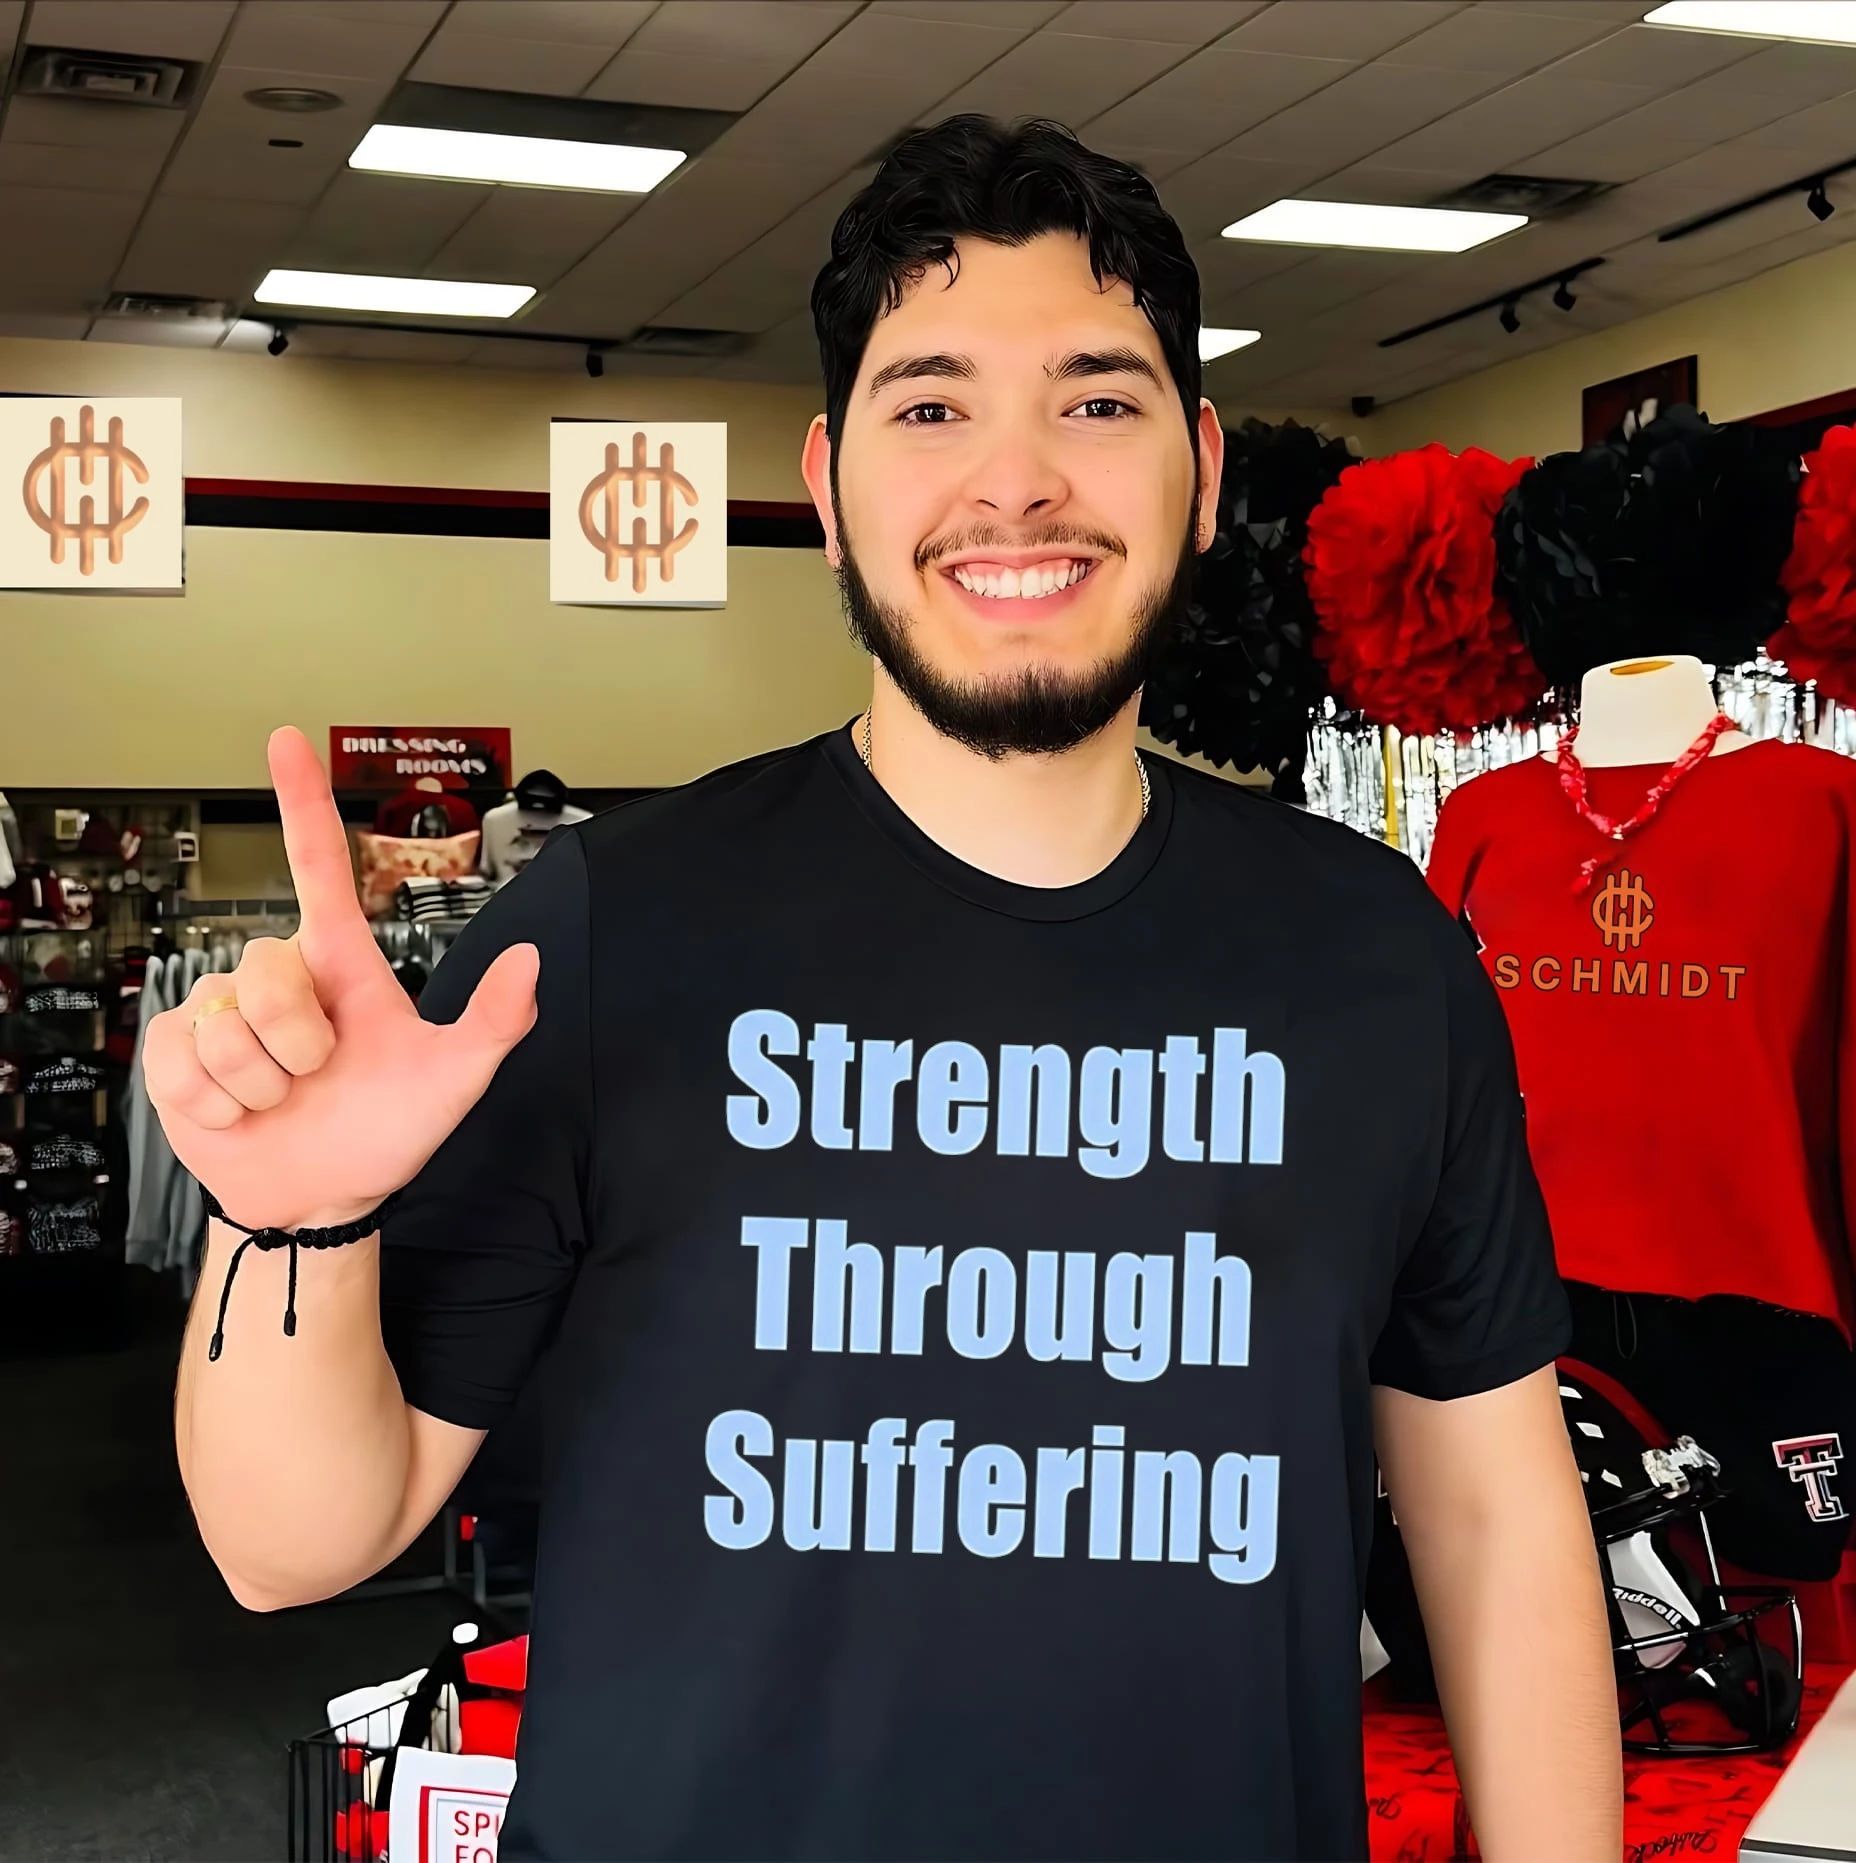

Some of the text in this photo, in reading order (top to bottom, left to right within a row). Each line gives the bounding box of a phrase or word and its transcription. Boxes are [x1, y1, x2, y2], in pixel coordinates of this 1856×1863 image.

[342, 737, 466, 753] DRESSING
[396, 758, 487, 775] ROOMS
[1494, 954, 1747, 1000] SCHMIDT
[726, 1008, 1286, 1179] Strength
[740, 1216, 1252, 1383] Through
[703, 1409, 1280, 1585] Suffering
